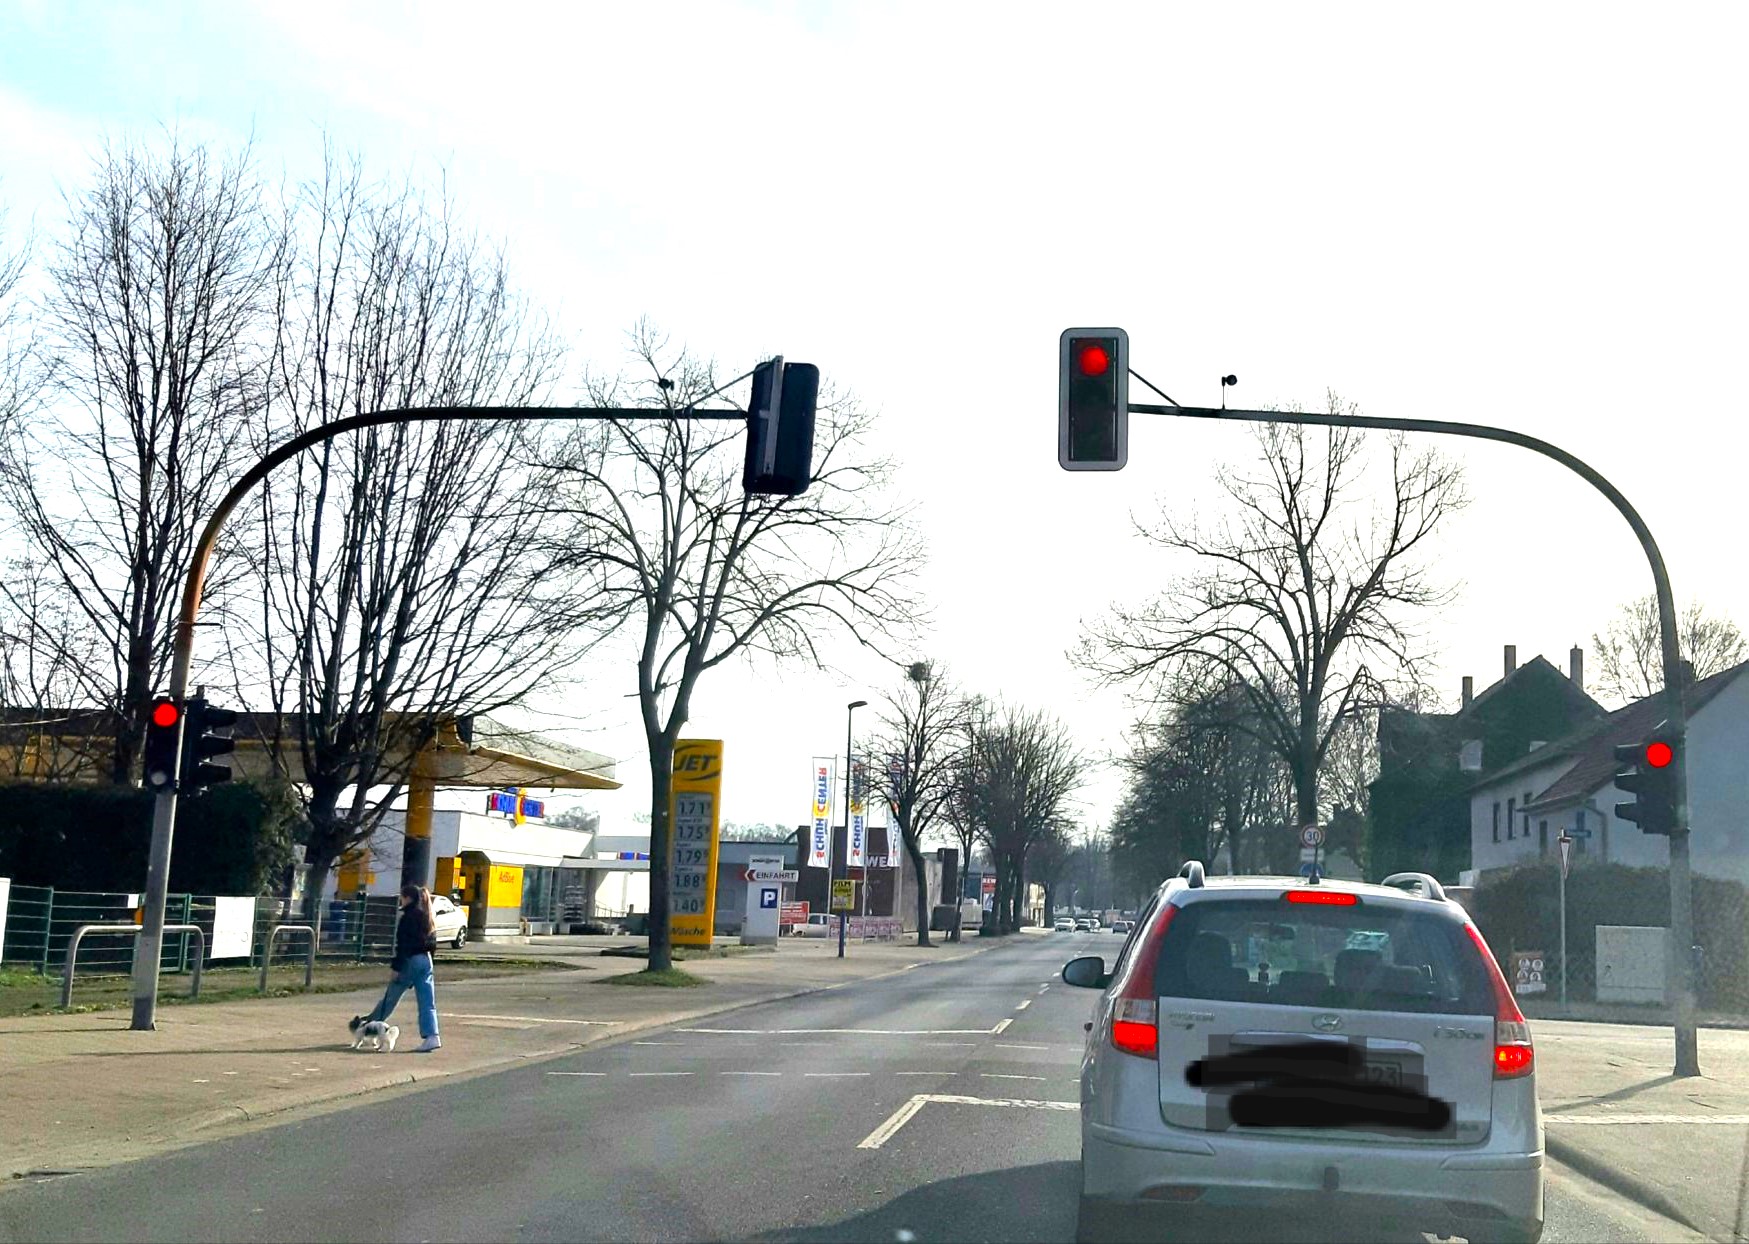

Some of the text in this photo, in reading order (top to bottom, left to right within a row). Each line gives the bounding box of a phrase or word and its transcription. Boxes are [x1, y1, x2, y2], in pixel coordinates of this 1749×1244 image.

[674, 754, 719, 771] JET
[1307, 831, 1319, 841] 30
[763, 891, 776, 906] P
